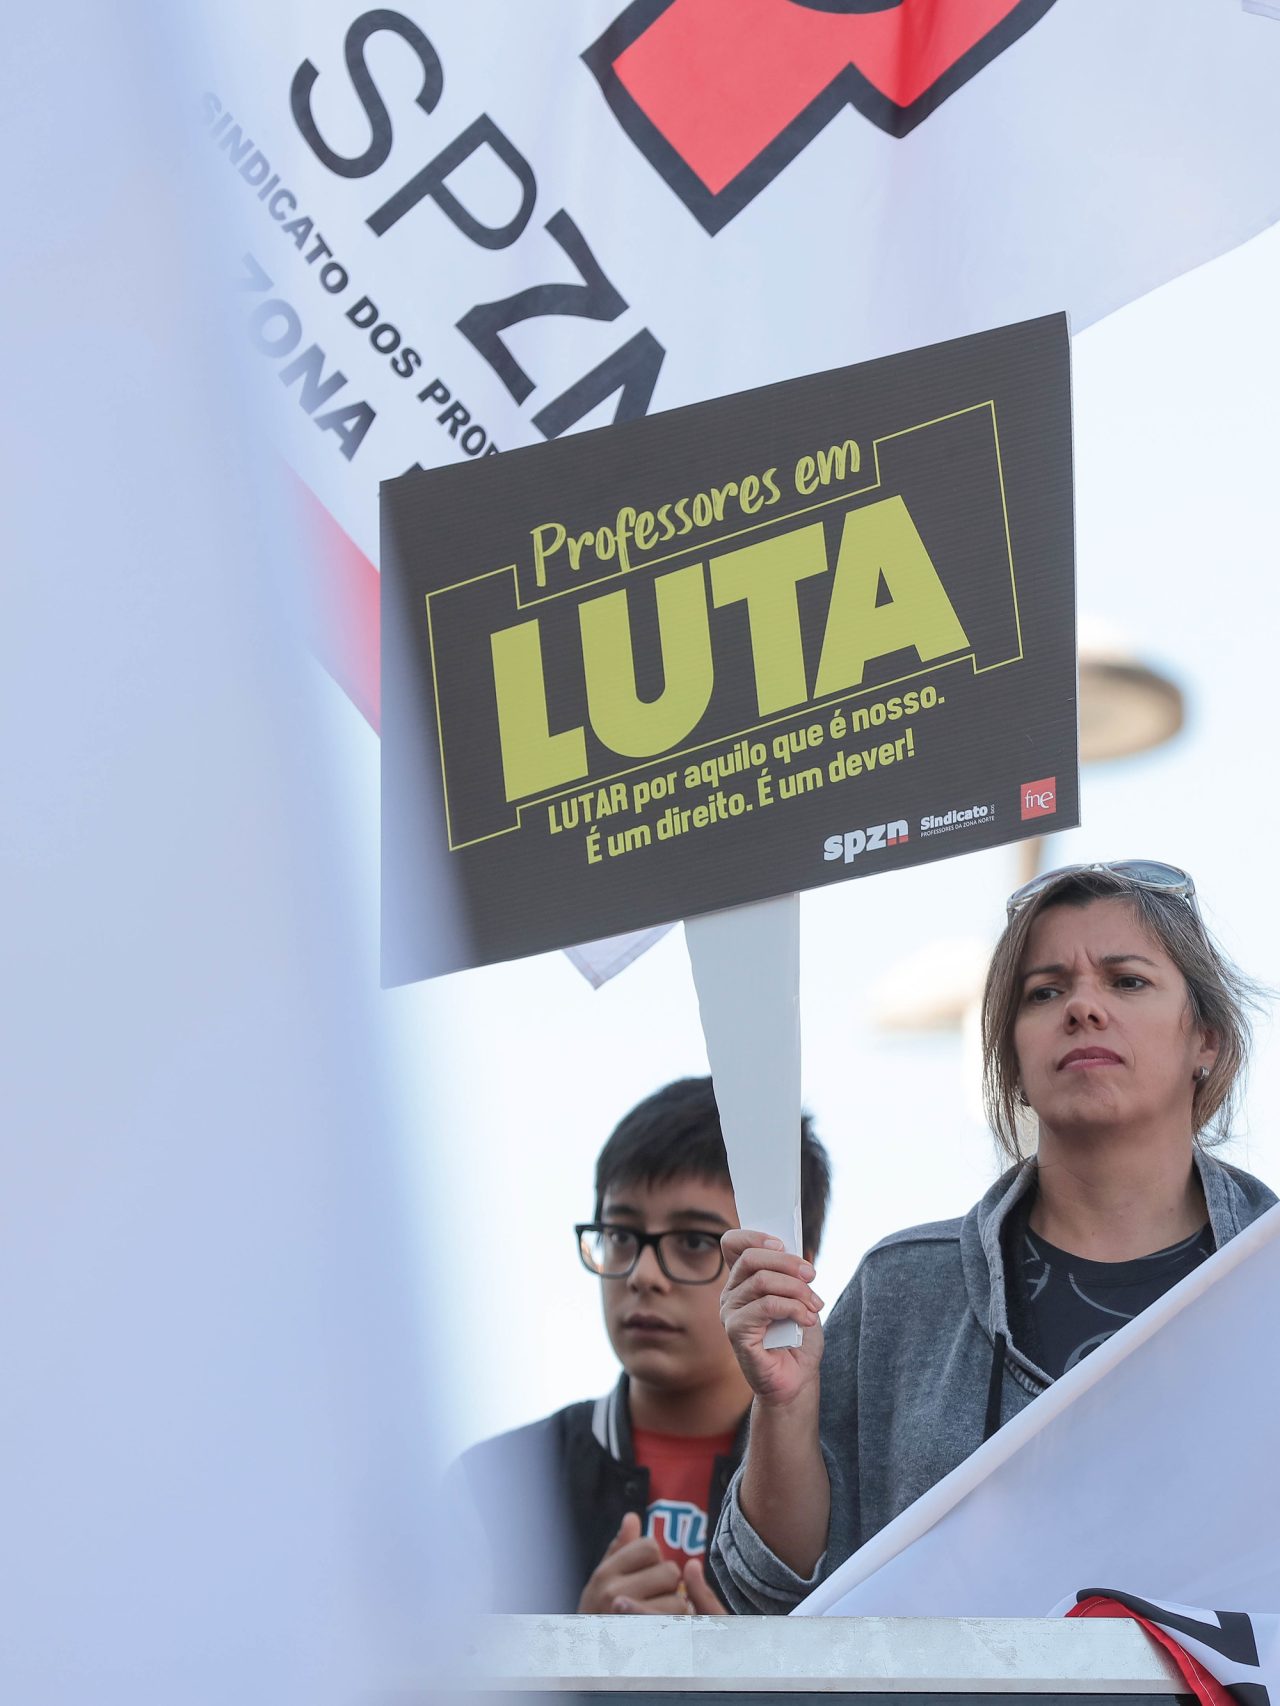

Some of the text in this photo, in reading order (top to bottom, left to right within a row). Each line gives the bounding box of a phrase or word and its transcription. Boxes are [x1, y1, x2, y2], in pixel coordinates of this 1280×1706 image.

[345, 296, 422, 379] DOS
[530, 440, 860, 587] Professores em
[490, 495, 971, 802] LUTA
[548, 686, 945, 834] LUTAR por aquilo que é nosso.
[586, 727, 915, 864] É um direito. É um dever!
[1023, 789, 1054, 810] fne
[823, 819, 909, 865] spzn
[920, 805, 989, 831] Sindicato
